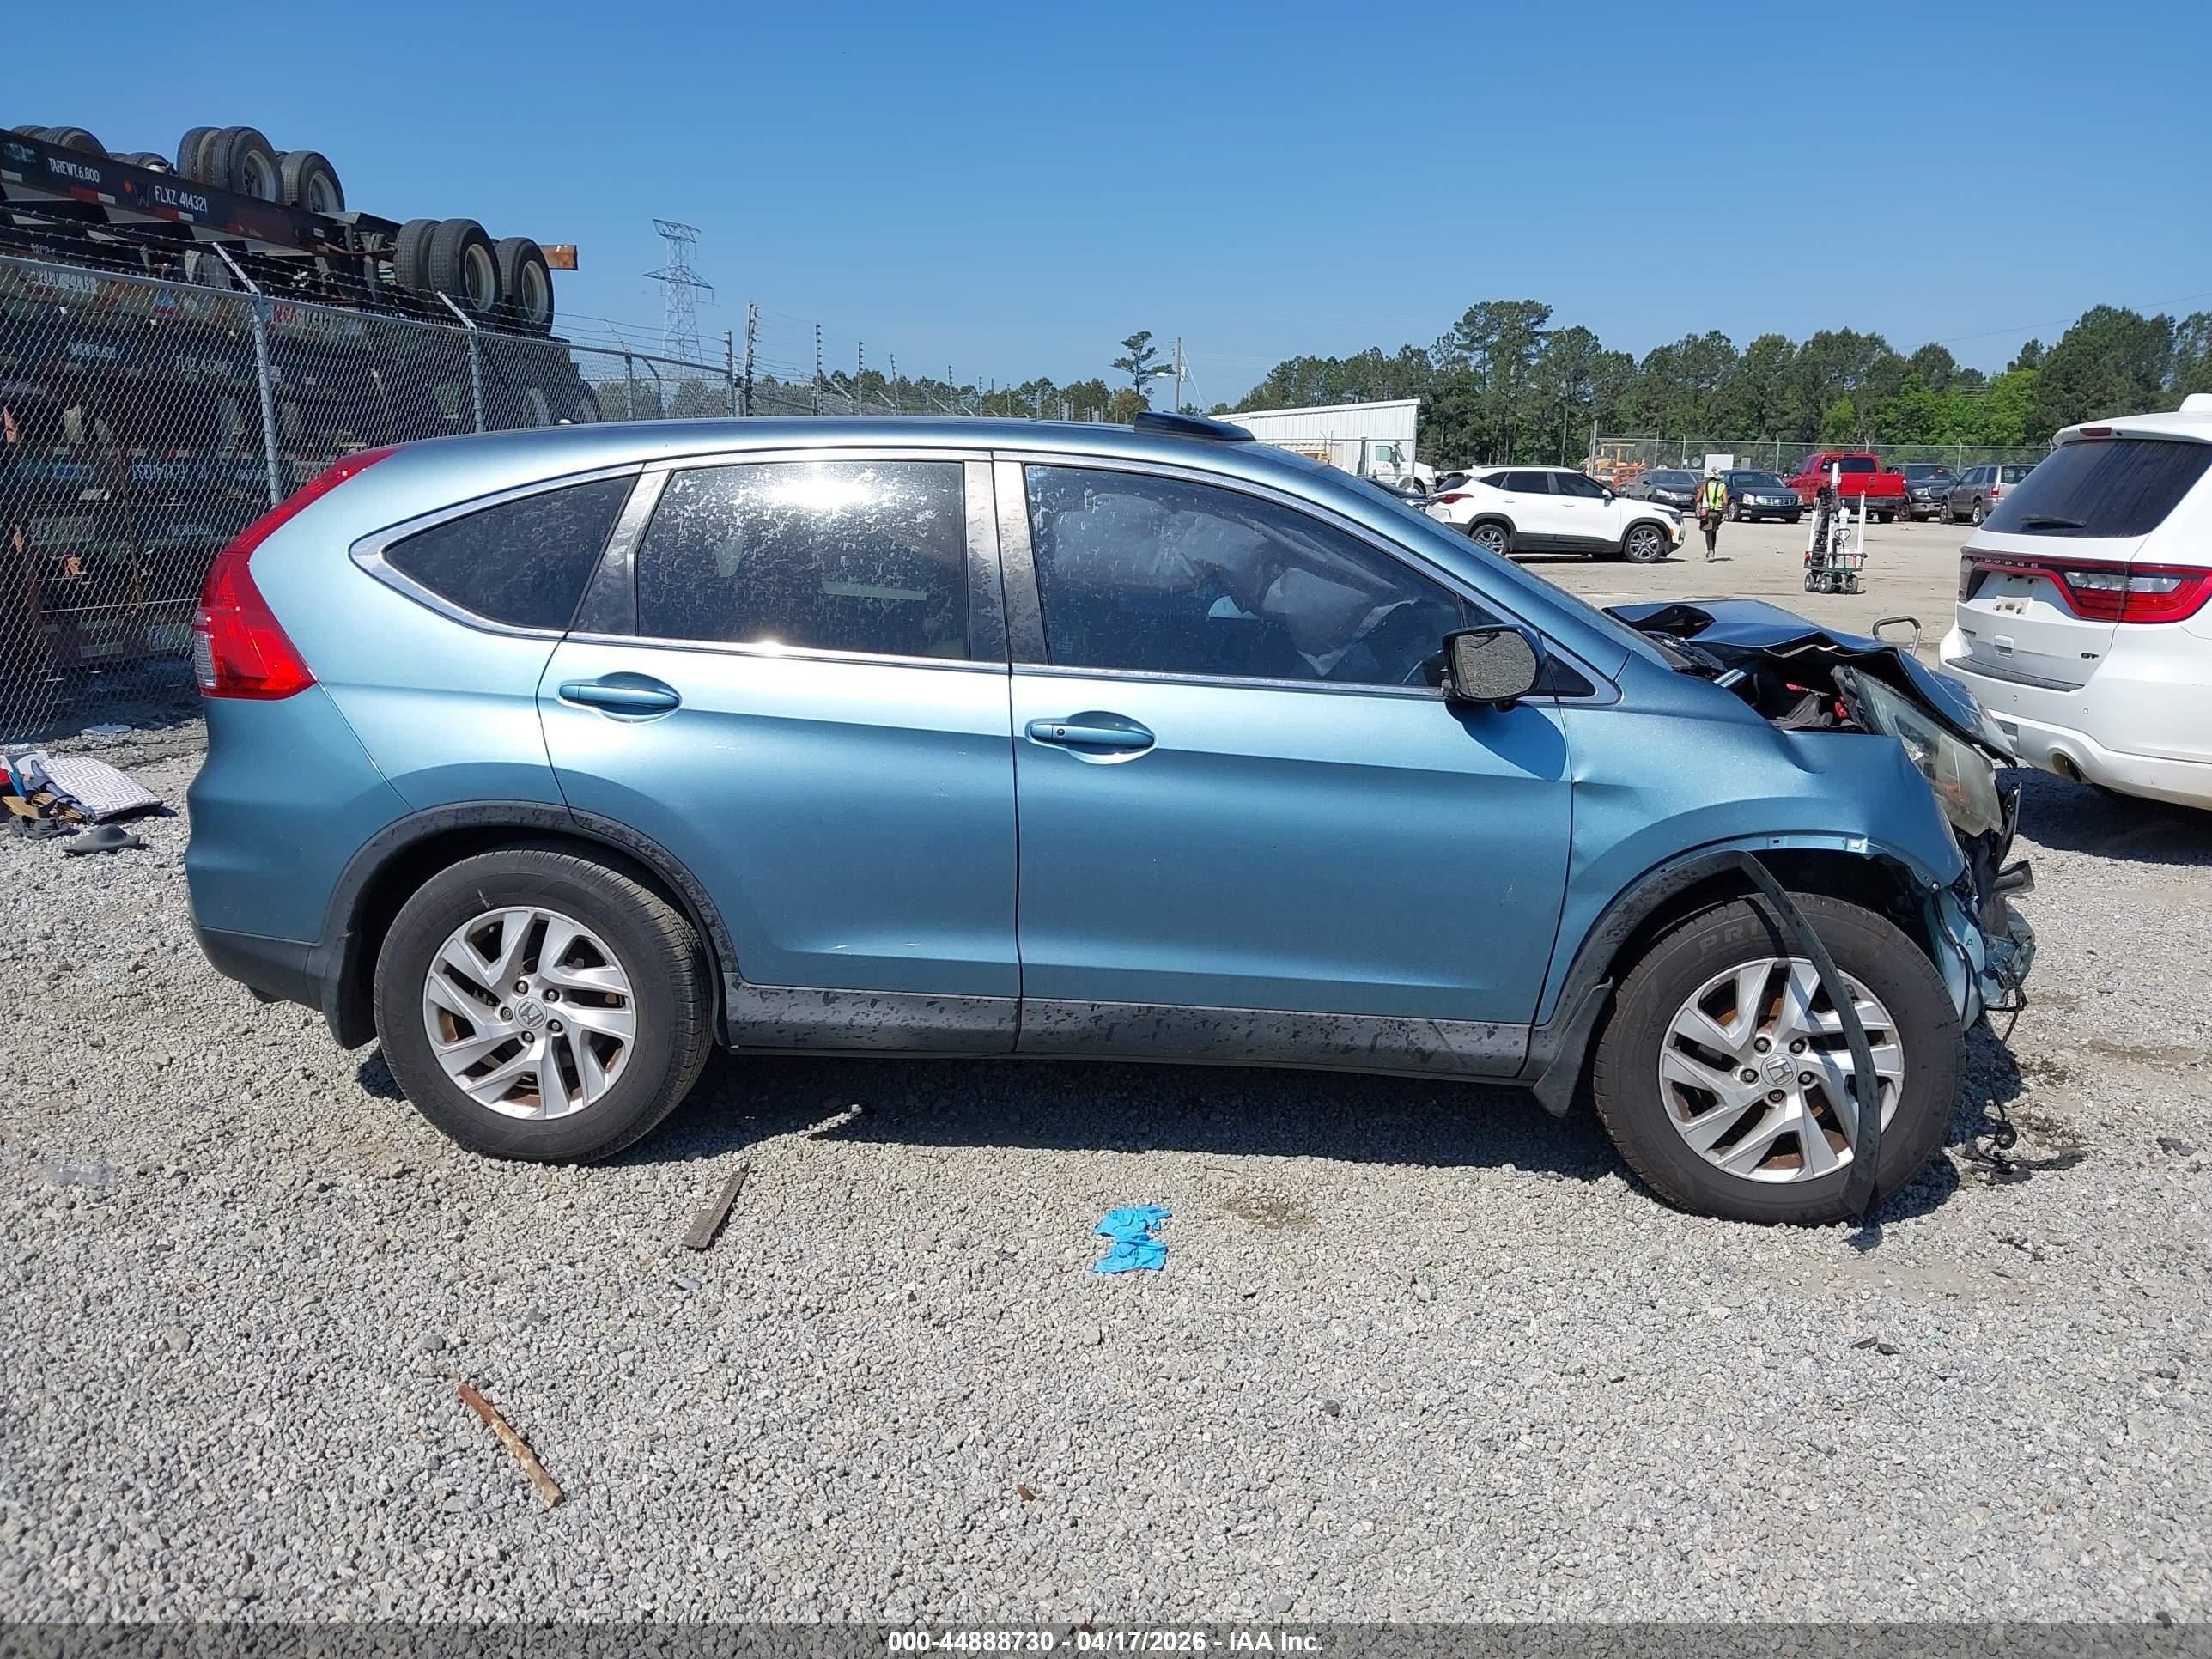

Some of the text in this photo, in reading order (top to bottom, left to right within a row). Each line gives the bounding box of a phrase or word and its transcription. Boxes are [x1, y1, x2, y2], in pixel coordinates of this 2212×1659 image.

[154, 185, 208, 214] FLXZ 414321
[1984, 558, 2039, 568] DODGE
